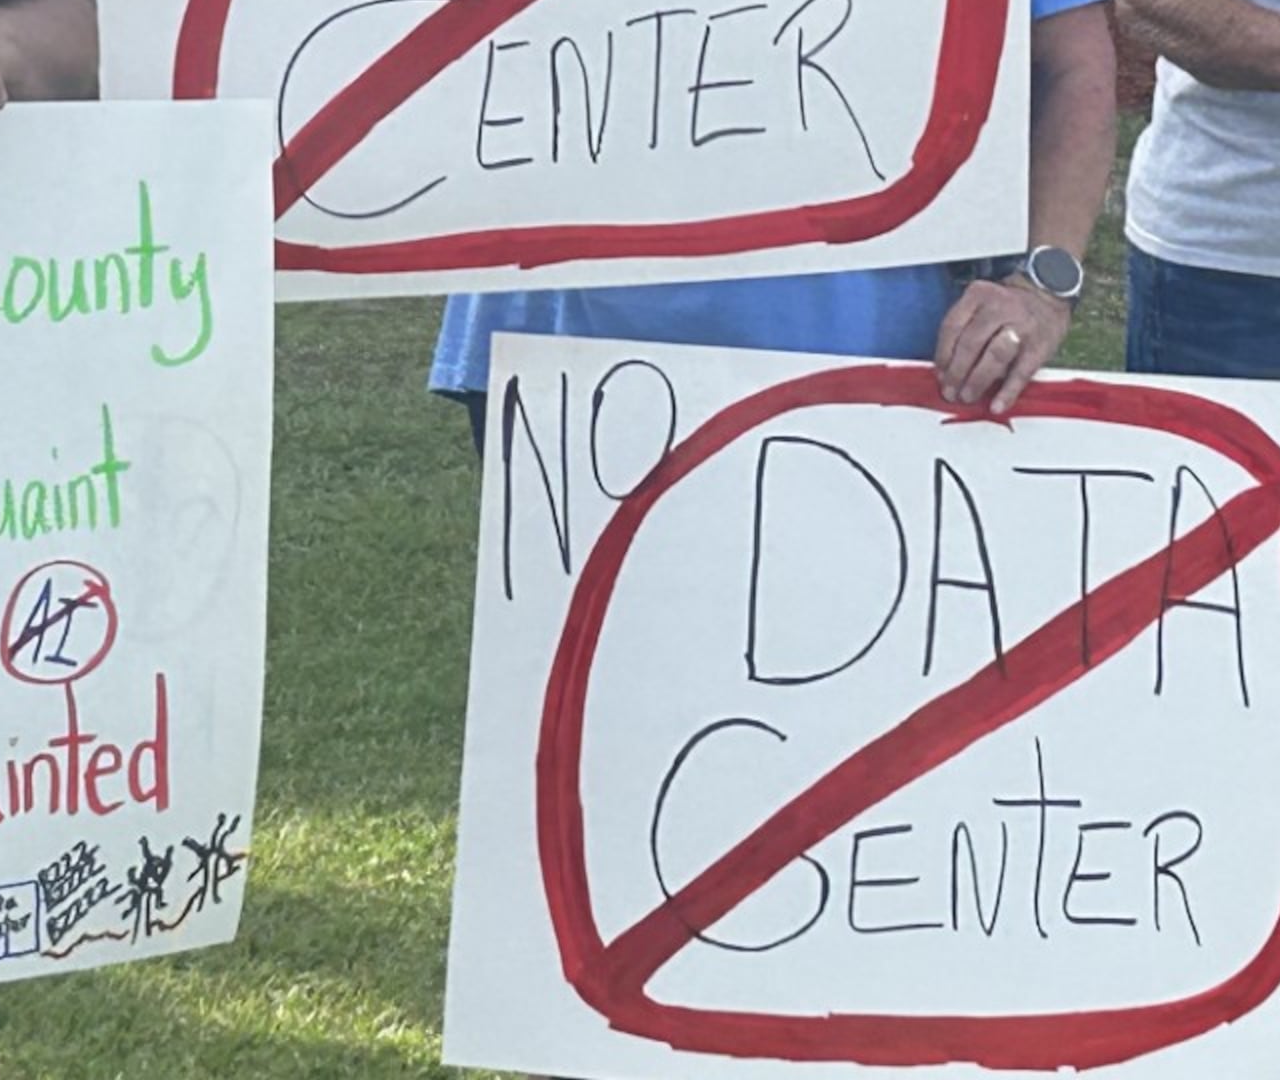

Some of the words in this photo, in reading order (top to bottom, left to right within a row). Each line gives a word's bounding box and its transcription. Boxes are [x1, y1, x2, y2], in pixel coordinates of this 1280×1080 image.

[502, 360, 677, 600] NO
[745, 436, 1250, 707] DATA
[9, 577, 98, 667] AI
